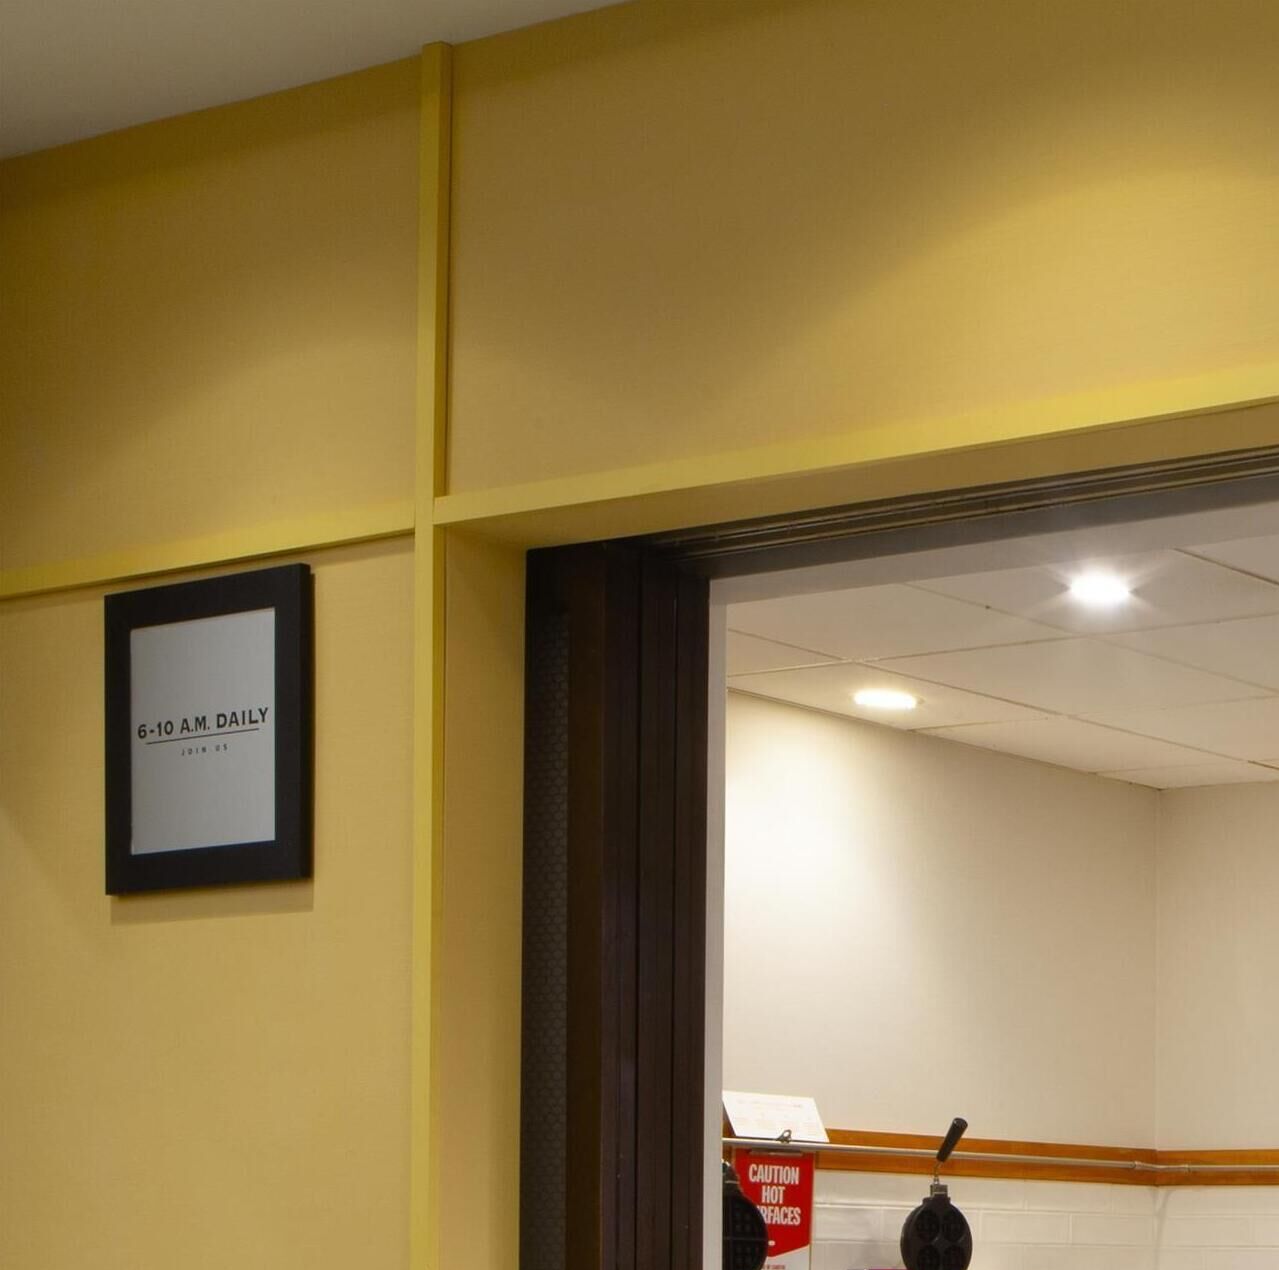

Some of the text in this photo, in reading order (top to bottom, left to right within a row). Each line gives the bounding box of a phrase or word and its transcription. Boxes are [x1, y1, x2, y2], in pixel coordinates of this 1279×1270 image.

[137, 707, 269, 740] 6-10 A.M. DAILY
[181, 743, 228, 756] JOIN US
[748, 1163, 800, 1185] CAUTION
[761, 1185, 786, 1204] HOT
[757, 1205, 802, 1226] RFACES
